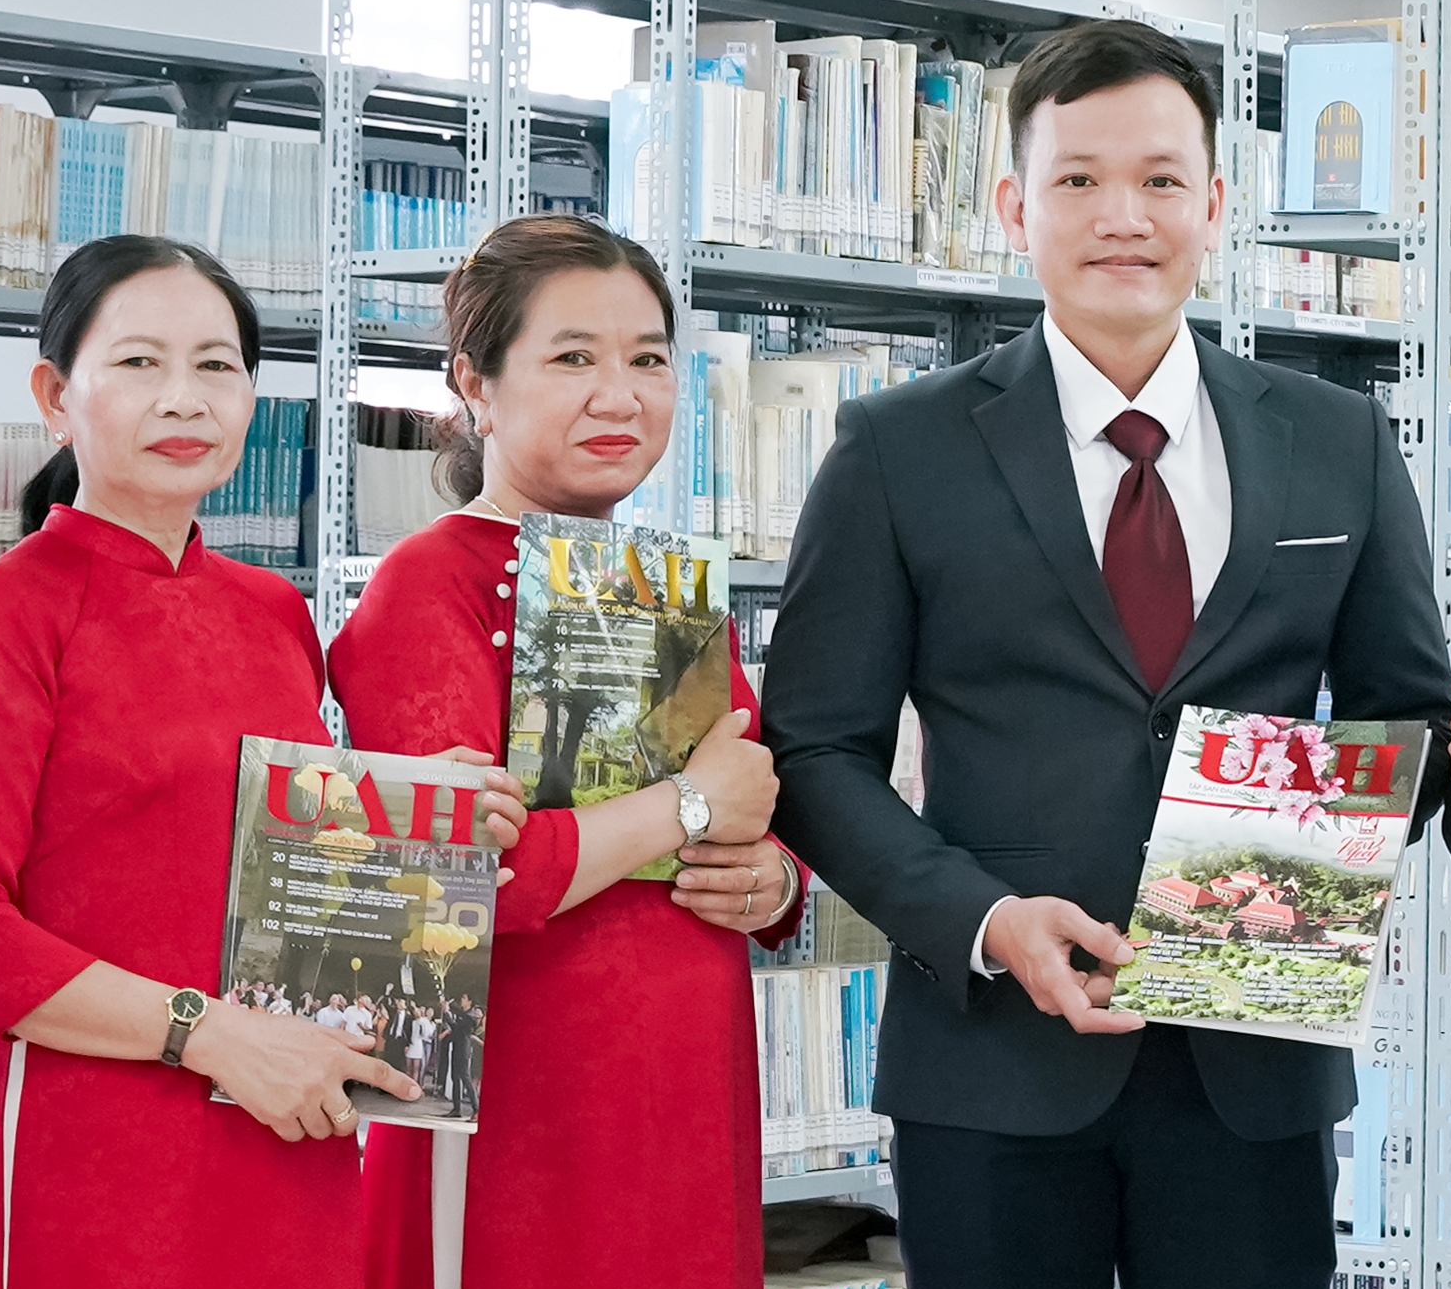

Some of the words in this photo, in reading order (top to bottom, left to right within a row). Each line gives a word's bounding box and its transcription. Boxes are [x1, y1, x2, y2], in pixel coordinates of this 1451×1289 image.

[548, 537, 710, 612] UAH
[1198, 728, 1407, 794] UAH
[266, 763, 483, 845] UAH
[271, 851, 286, 863] 20
